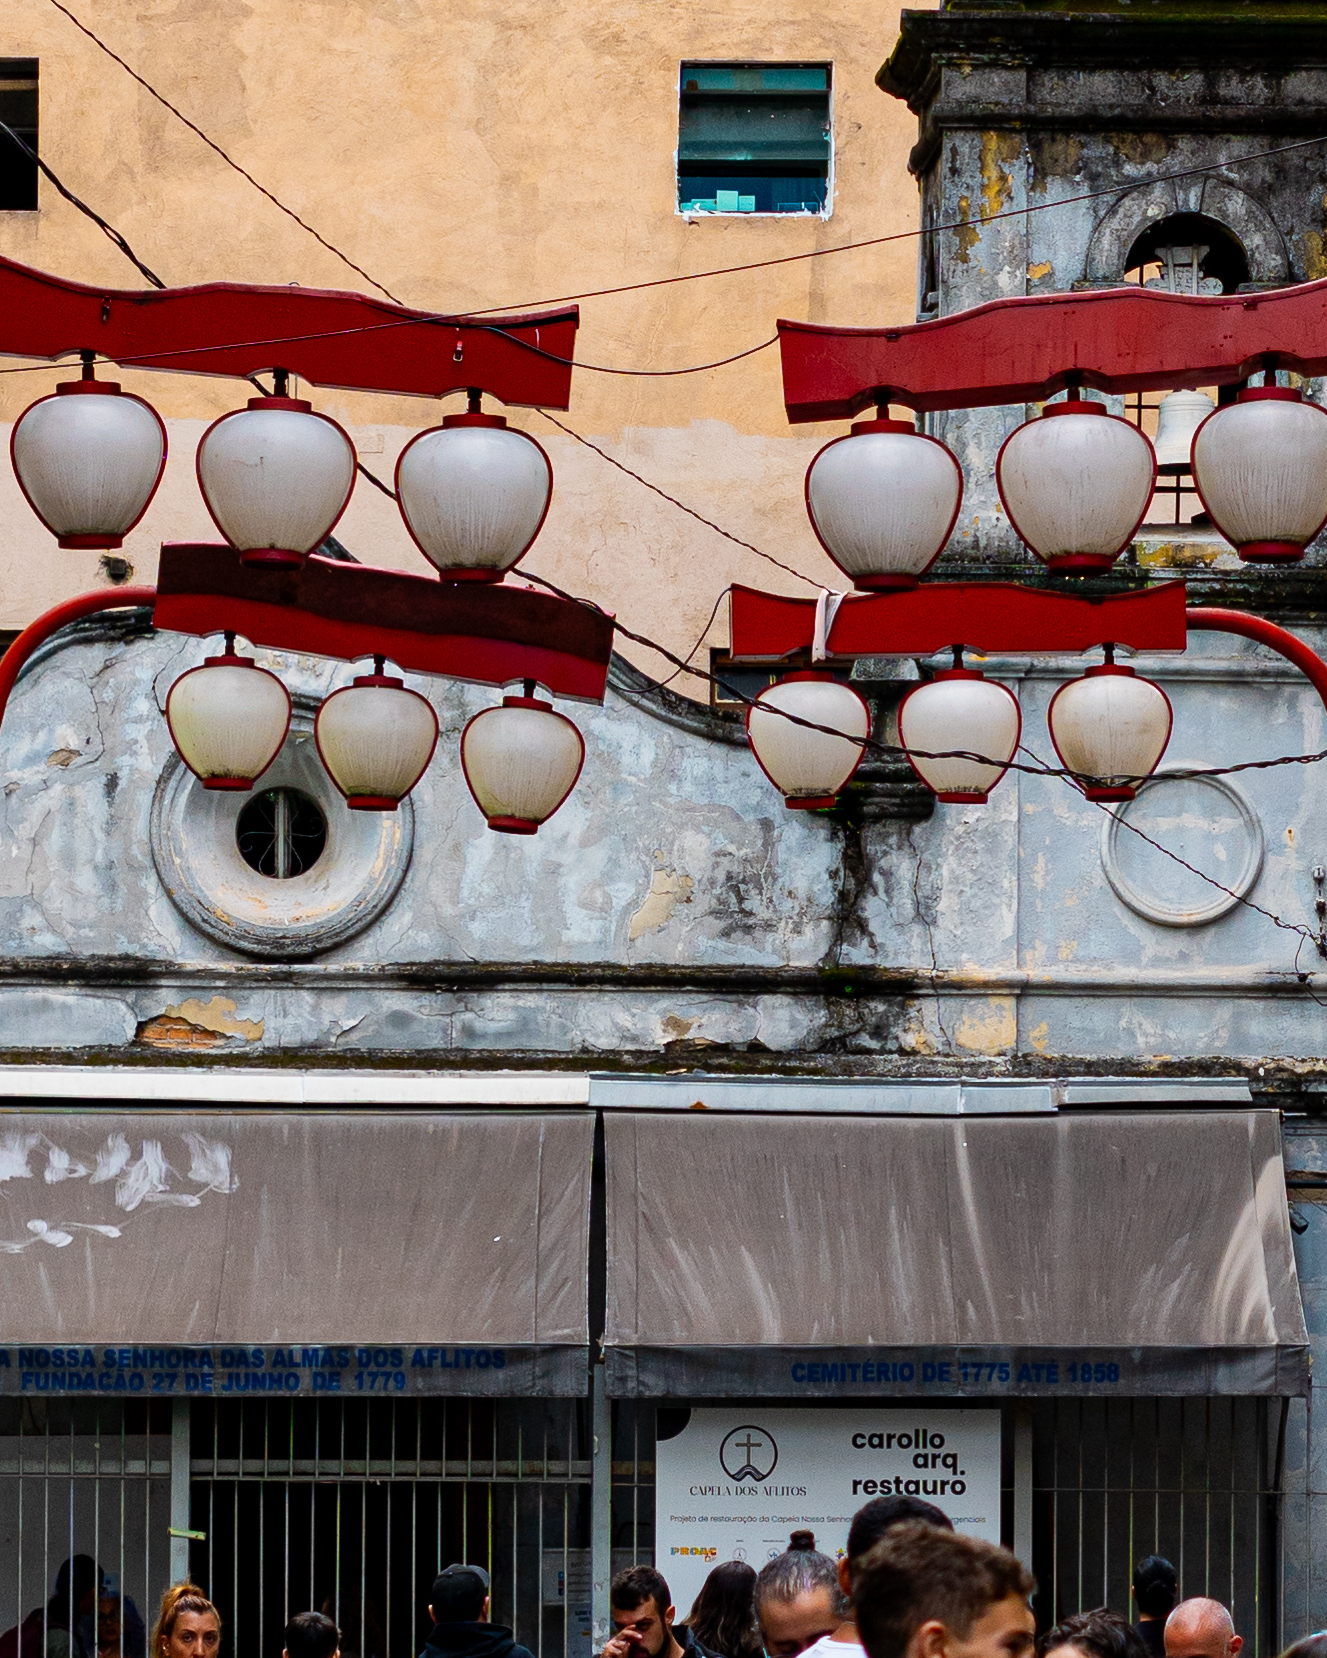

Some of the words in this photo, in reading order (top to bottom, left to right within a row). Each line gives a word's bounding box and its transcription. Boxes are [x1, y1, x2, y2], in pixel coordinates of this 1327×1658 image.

[17, 1348, 96, 1369] NOSSA
[102, 1348, 214, 1369] SENHORA
[220, 1348, 265, 1369] DAS
[271, 1348, 350, 1369] ALMAS
[357, 1348, 404, 1369] DOS
[411, 1348, 506, 1370] AFLITOS
[151, 1371, 178, 1392] 27
[185, 1371, 214, 1392] DE
[221, 1371, 301, 1392] JUNHO
[312, 1371, 342, 1392] DE
[354, 1371, 407, 1392] 1779
[791, 1358, 915, 1383] CEMITÉRIO
[921, 1362, 952, 1383] DE
[959, 1362, 1011, 1383] 1775
[1016, 1359, 1060, 1384] ATÉ
[1067, 1362, 1120, 1383] 1858
[851, 1428, 946, 1450] carollo
[912, 1452, 966, 1476] arq.
[689, 1485, 731, 1497] CAPELA
[735, 1485, 758, 1497] DOS
[851, 1475, 967, 1496] restauro
[670, 1514, 697, 1525] Projeto
[697, 1514, 709, 1523] de
[709, 1514, 757, 1524] restauração
[758, 1514, 770, 1523] da
[771, 1514, 800, 1524] Capela
[801, 1514, 825, 1523] Nossa
